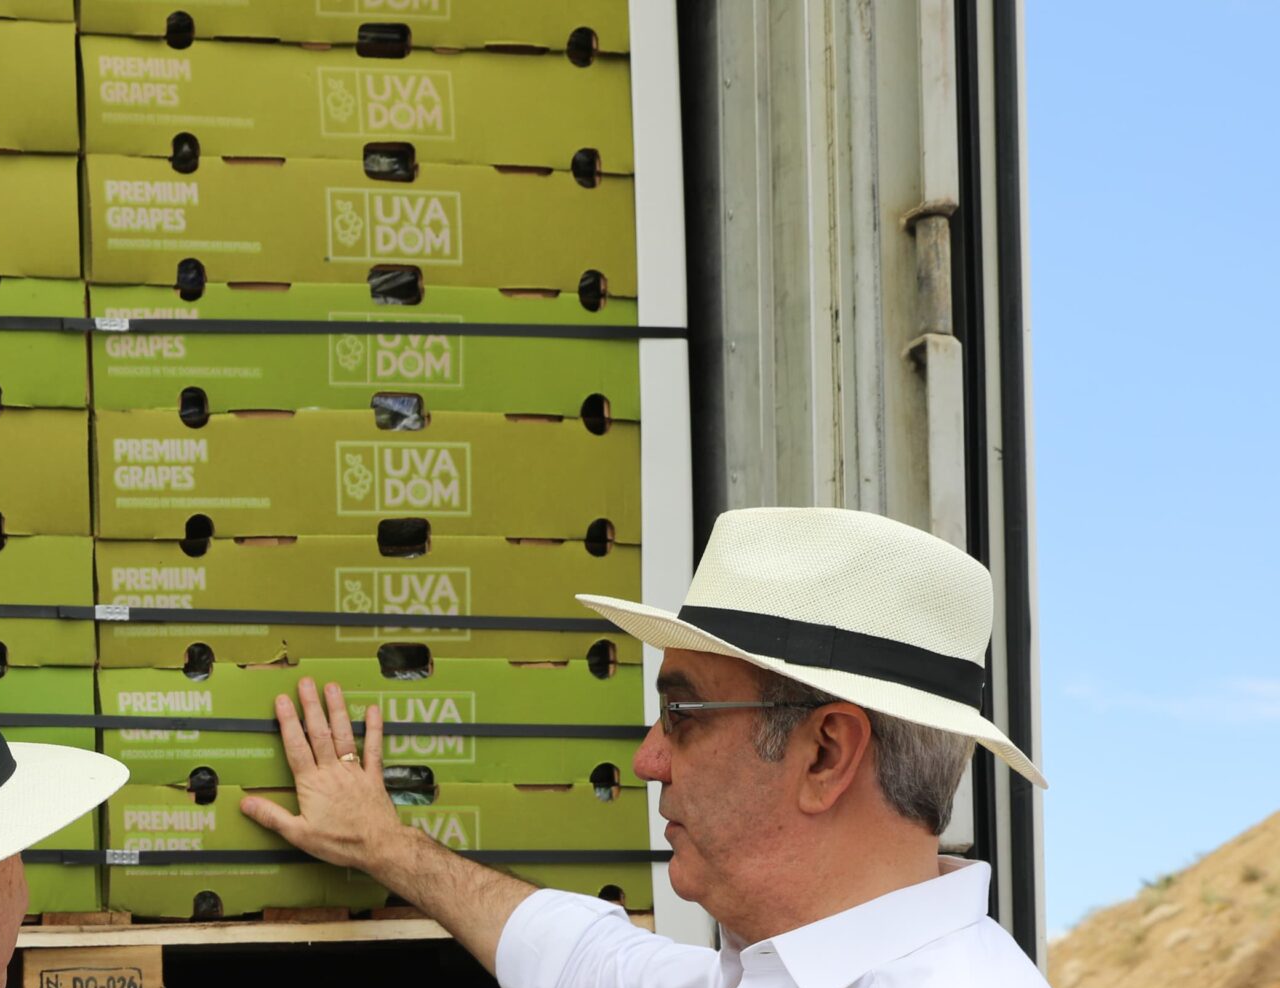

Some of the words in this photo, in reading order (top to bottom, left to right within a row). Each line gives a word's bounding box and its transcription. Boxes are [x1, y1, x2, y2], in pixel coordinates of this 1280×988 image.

[98, 55, 192, 82] PREMIUM
[100, 80, 180, 107] GRAPES
[366, 74, 441, 103] UVA
[367, 101, 444, 132] DOM
[105, 180, 199, 207] PREMIUM
[107, 206, 187, 232] GRAPES
[374, 195, 449, 226] UVA
[375, 224, 451, 256] DOM
[105, 333, 187, 358] GRAPES
[376, 348, 451, 379] DOM
[113, 438, 208, 463] PREMIUM
[383, 448, 459, 478] UVA
[114, 465, 195, 490] GRAPES
[384, 477, 460, 508] DOM
[112, 567, 206, 591] PREMIUM
[383, 574, 459, 603] UVA
[118, 691, 213, 713] PREMIUM
[389, 697, 463, 724] UVA
[124, 808, 216, 832] PREMIUM
[411, 816, 469, 850] VA
